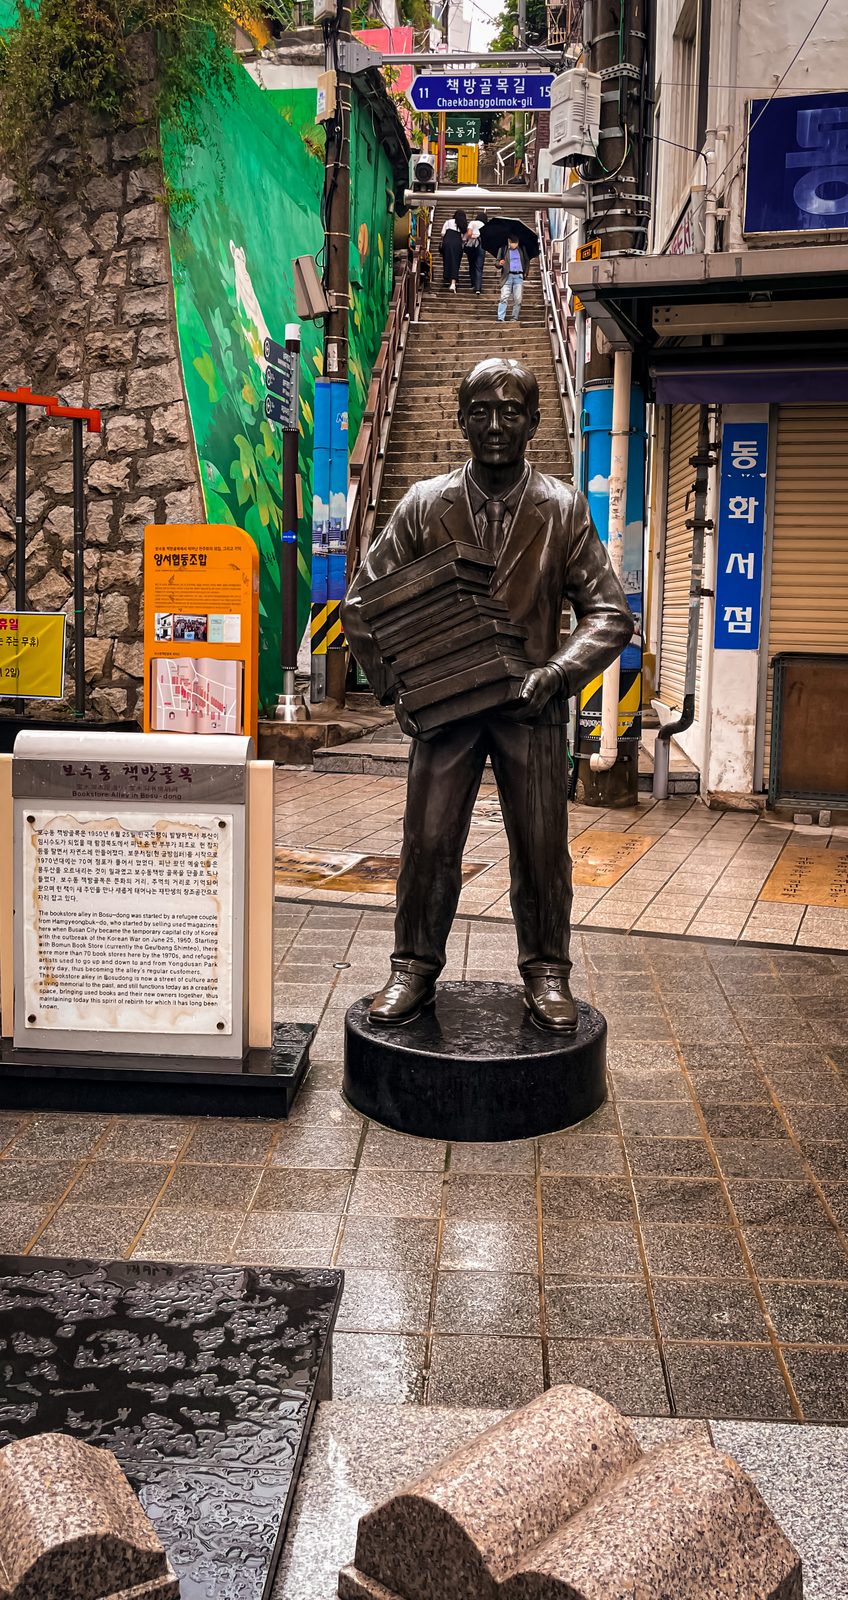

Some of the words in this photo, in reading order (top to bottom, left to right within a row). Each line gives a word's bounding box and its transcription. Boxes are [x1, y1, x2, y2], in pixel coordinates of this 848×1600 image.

[446, 78, 525, 95] 책방골목길
[540, 86, 551, 98] 15
[418, 88, 429, 99] 11
[437, 97, 533, 109] Chaekbanggolmok-gil
[723, 440, 760, 633] 동화서점
[154, 553, 208, 567] 양서협동조합
[5, 668, 20, 679] 2일)
[62, 764, 111, 781] 보수동
[122, 764, 192, 784] 책방골목
[140, 792, 182, 801] Bosu-dong
[98, 911, 130, 919] Bosu-dong
